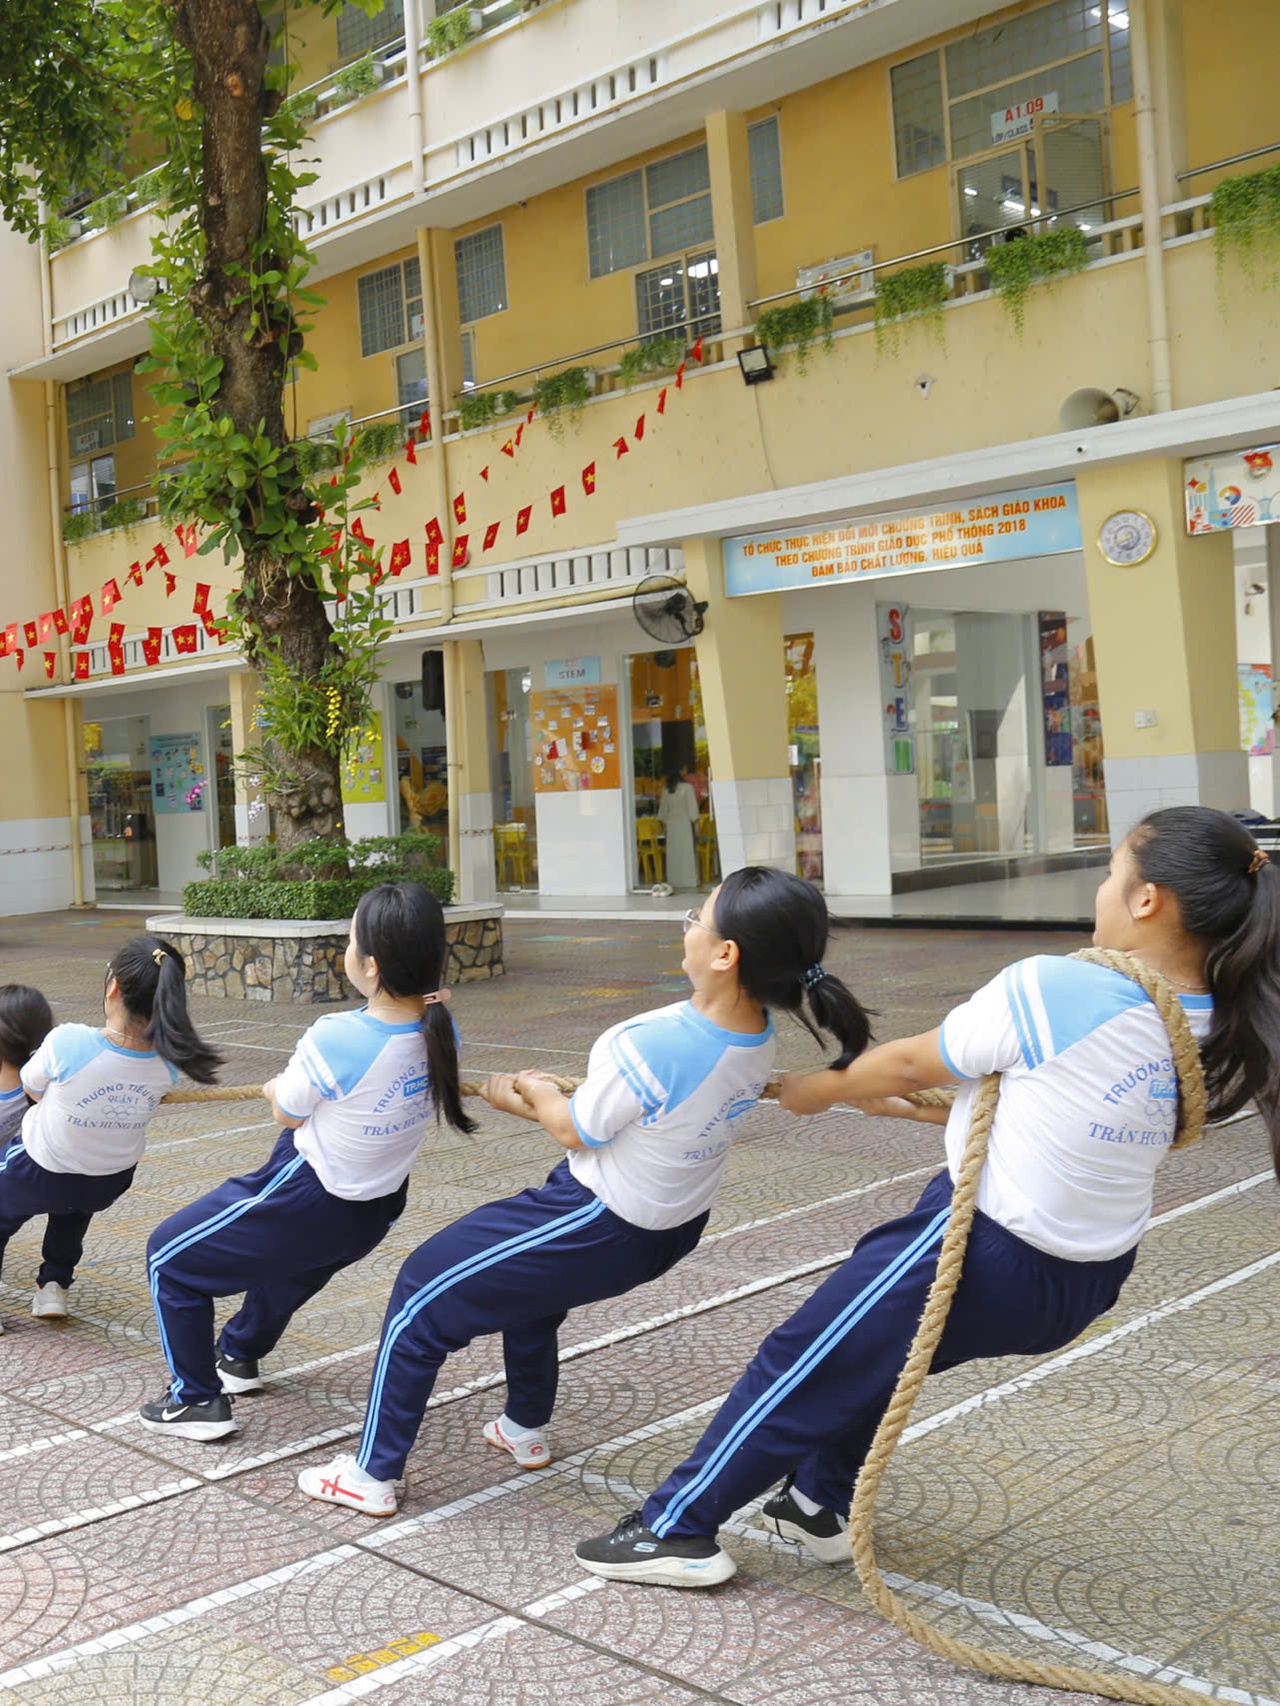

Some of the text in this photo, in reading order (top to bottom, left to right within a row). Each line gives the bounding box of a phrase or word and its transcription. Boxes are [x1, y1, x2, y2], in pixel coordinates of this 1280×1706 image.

[1005, 97, 1044, 123] A1.09
[968, 505, 999, 522] SÁCH
[1002, 499, 1030, 516] GIÁO
[1034, 495, 1066, 512] KHOA
[775, 555, 799, 567] THEO
[878, 537, 903, 552] GIÁO
[958, 524, 994, 540] THÔNG
[998, 518, 1026, 535] 2018
[861, 553, 886, 571] CHẤT
[559, 668, 586, 681] STEM
[1103, 1058, 1172, 1106] TRƯỜNG
[1088, 1121, 1138, 1144] TRẦN
